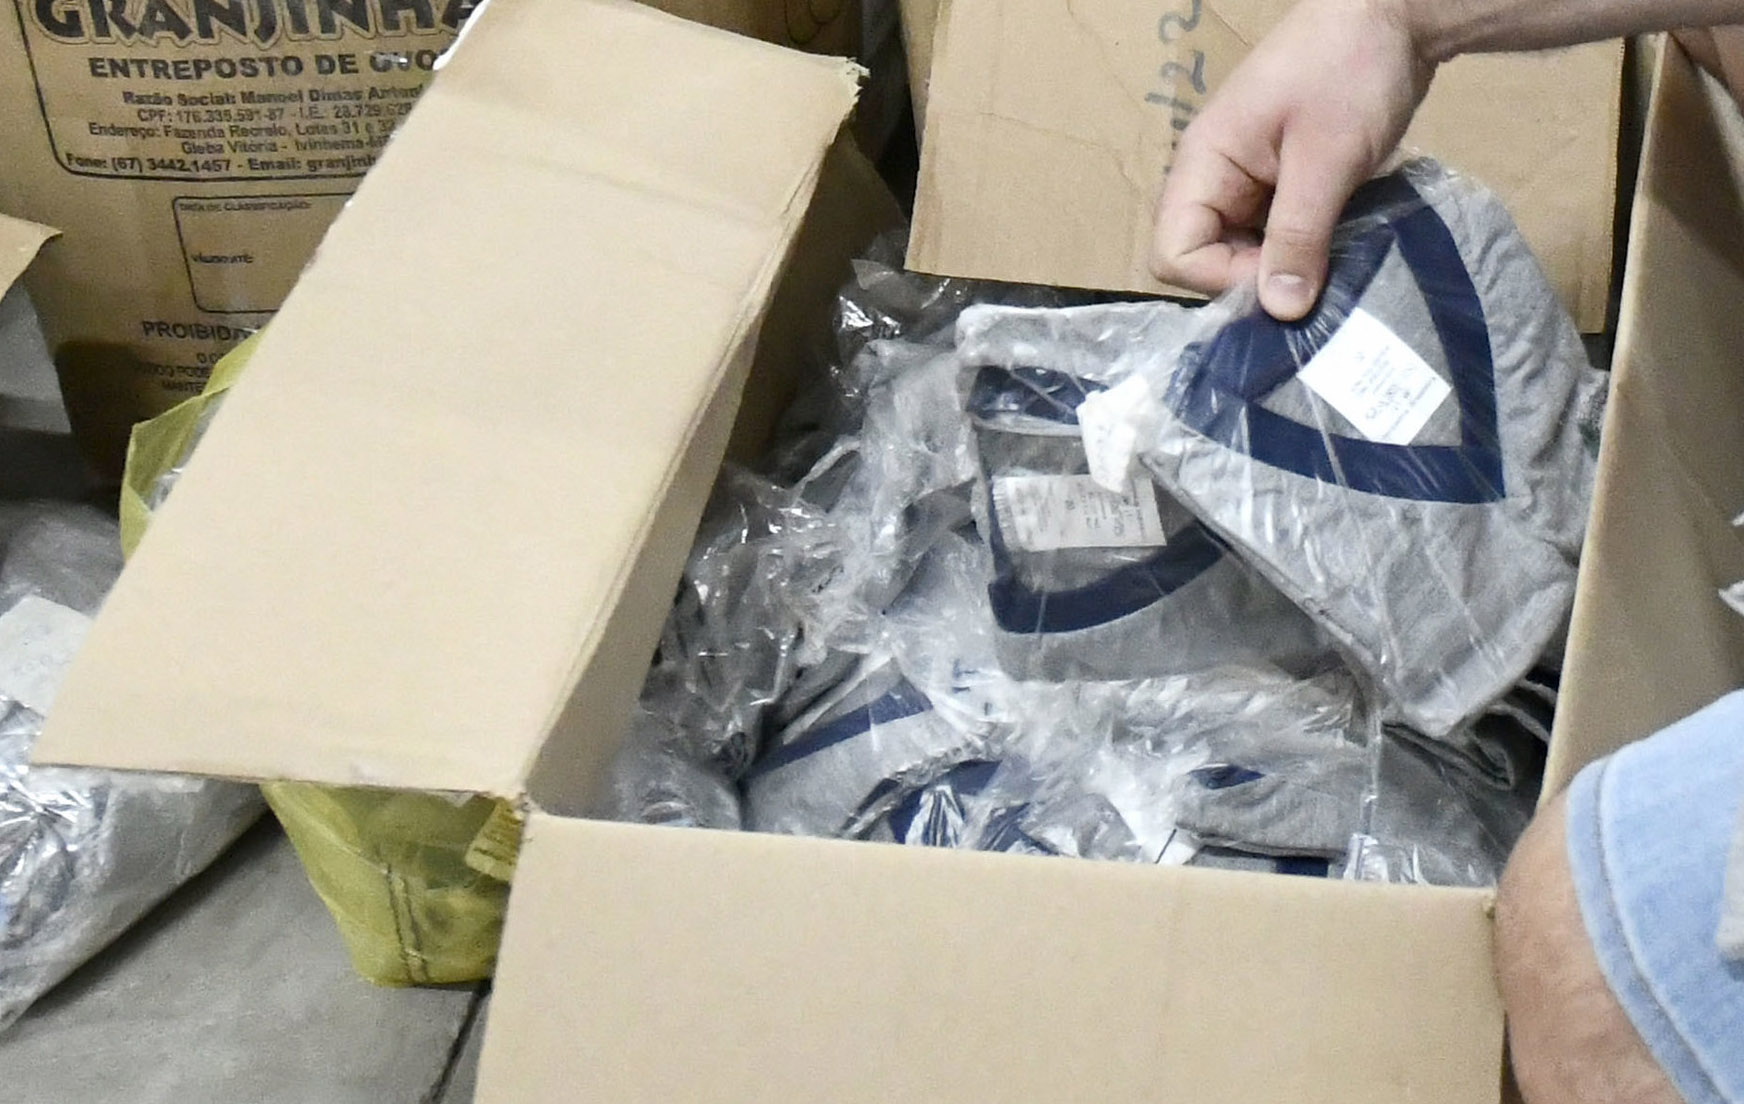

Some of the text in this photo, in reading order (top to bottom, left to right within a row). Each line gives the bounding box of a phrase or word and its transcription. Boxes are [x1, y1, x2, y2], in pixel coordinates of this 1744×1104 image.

[89, 47, 445, 80] ENTREPOSTO DE OVO
[122, 91, 173, 106] Razão
[177, 90, 236, 106] Social:
[88, 122, 161, 140] Endereço:
[163, 125, 225, 139] Fazenda
[295, 122, 337, 137] Lotes
[181, 141, 225, 155] Gleba
[227, 139, 278, 154] Vitória
[65, 152, 107, 169] Fone:
[111, 156, 143, 173] (67)
[248, 157, 302, 171] Email:
